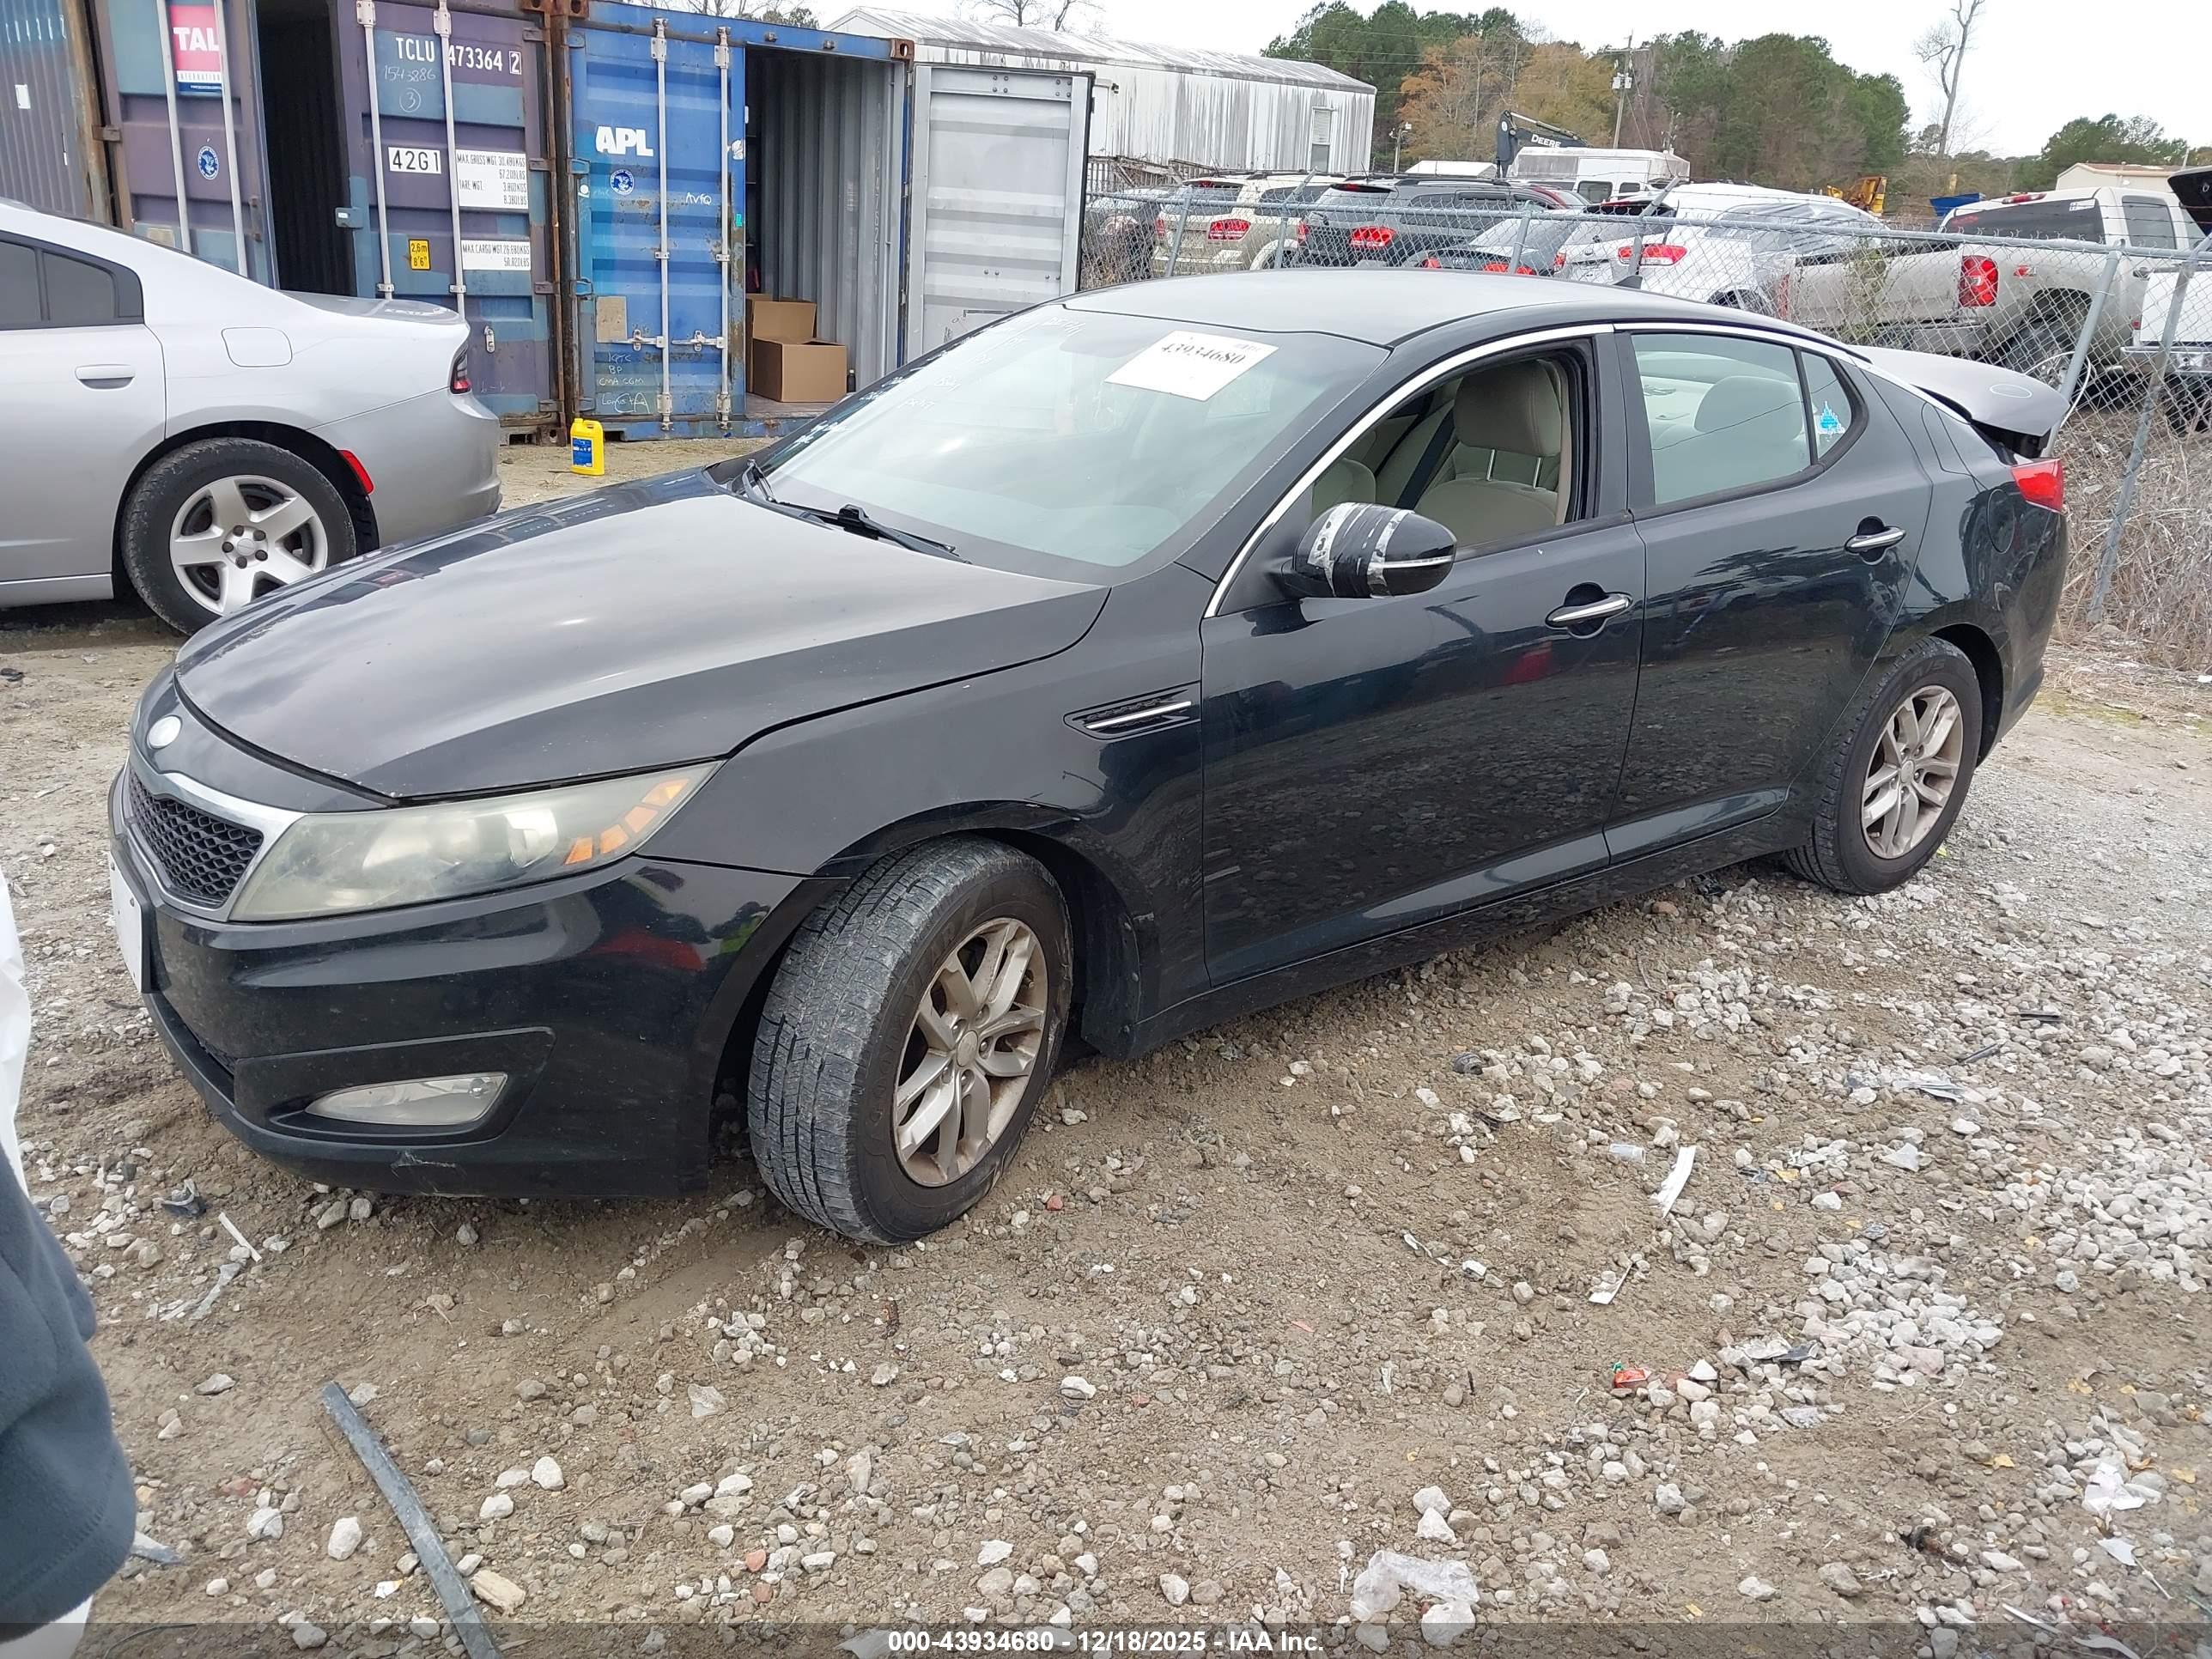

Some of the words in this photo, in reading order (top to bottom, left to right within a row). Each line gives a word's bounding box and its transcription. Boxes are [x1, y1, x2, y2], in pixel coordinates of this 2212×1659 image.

[173, 27, 220, 52] TAL
[396, 37, 435, 62] TCLU
[448, 45, 503, 71] 473364
[510, 52, 520, 75] 2
[596, 126, 653, 156] APL
[1531, 134, 1562, 149] DEERE
[392, 149, 439, 172] 42G1
